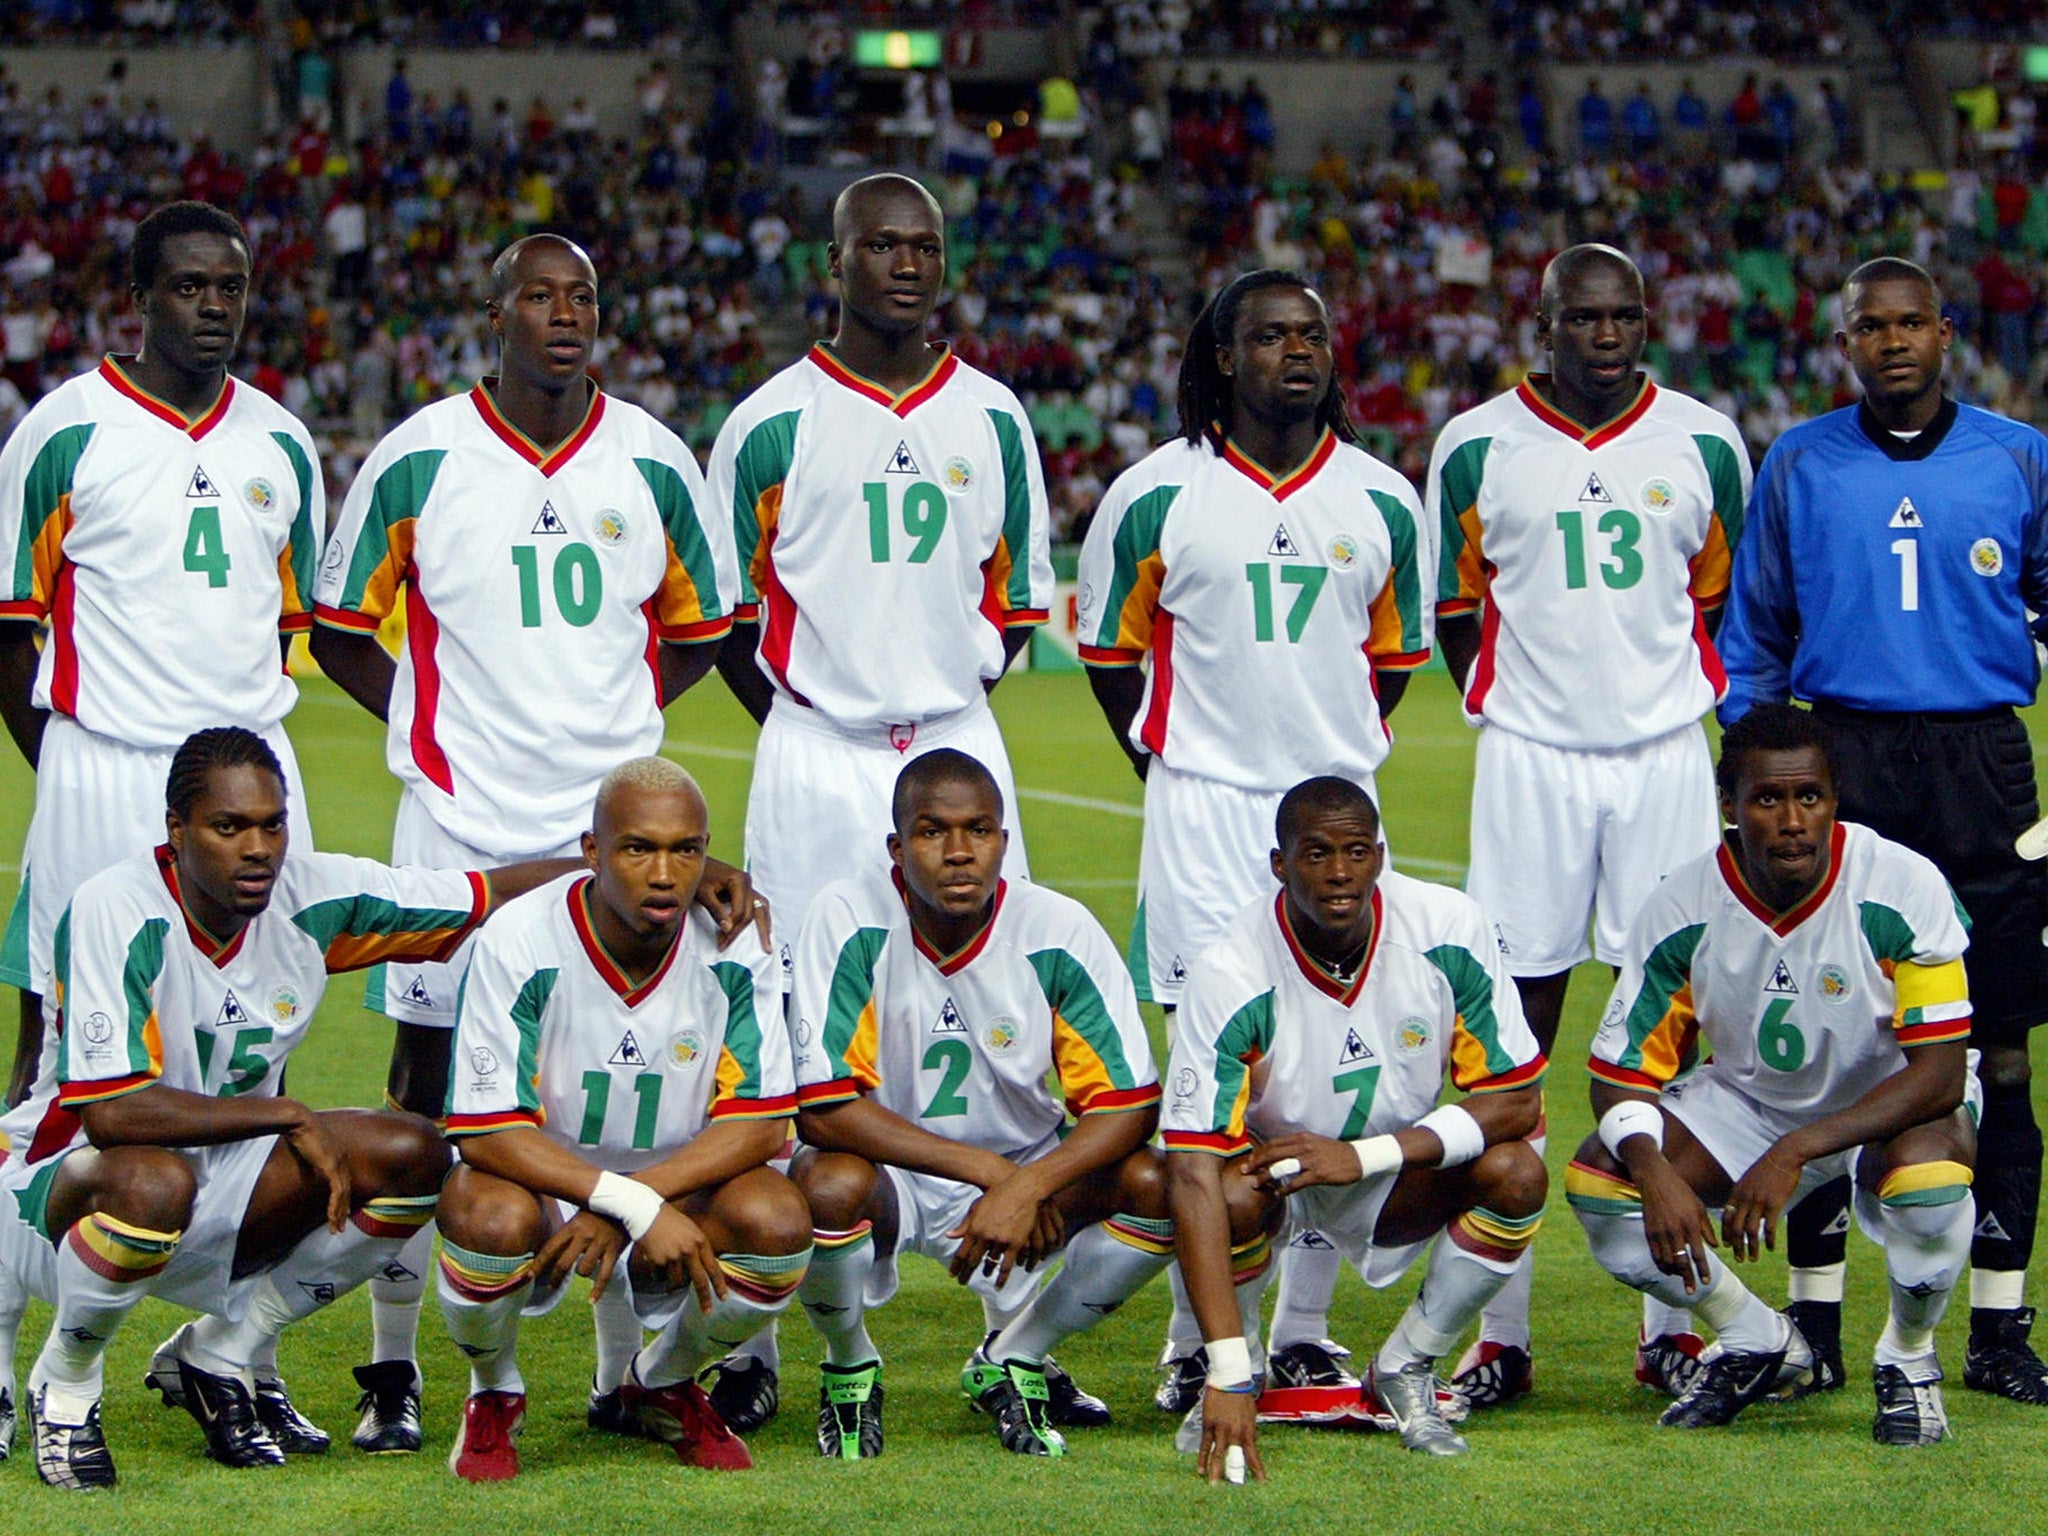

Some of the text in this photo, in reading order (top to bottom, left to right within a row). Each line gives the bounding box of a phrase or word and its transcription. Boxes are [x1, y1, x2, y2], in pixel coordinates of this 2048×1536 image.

[184, 507, 230, 588] 4
[864, 482, 948, 563] 19
[1557, 510, 1643, 589] 13
[512, 543, 602, 627] 10
[1247, 563, 1328, 643] 17
[1891, 538, 1918, 611] 1
[195, 1027, 273, 1097] 15
[1758, 997, 1806, 1072] 6
[581, 1071, 662, 1149] 11
[922, 1040, 971, 1117] 2
[1333, 1066, 1381, 1137] 7
